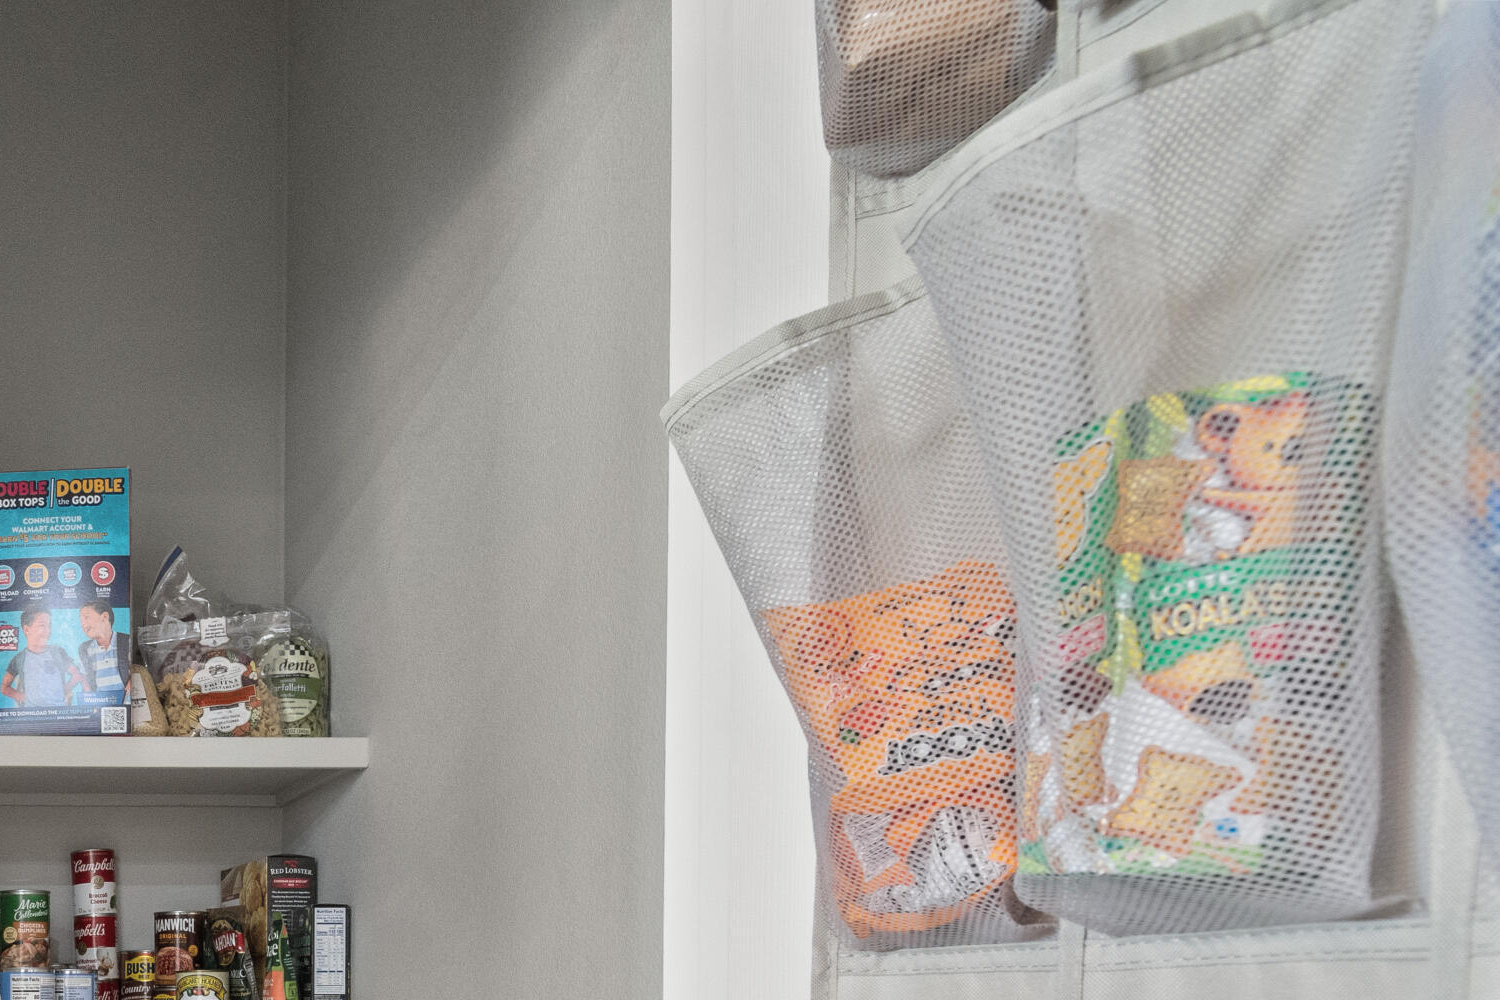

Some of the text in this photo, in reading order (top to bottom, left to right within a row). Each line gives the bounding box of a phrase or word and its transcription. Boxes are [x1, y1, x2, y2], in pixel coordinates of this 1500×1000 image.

[56, 478, 122, 498] DOUBLE
[18, 497, 44, 506] TOPS
[72, 495, 101, 505] GOOD
[12, 525, 48, 533] WALMART
[279, 658, 316, 673] dente
[285, 867, 313, 876] LOBSTER
[15, 899, 47, 911] Marie
[121, 985, 151, 994] Country
